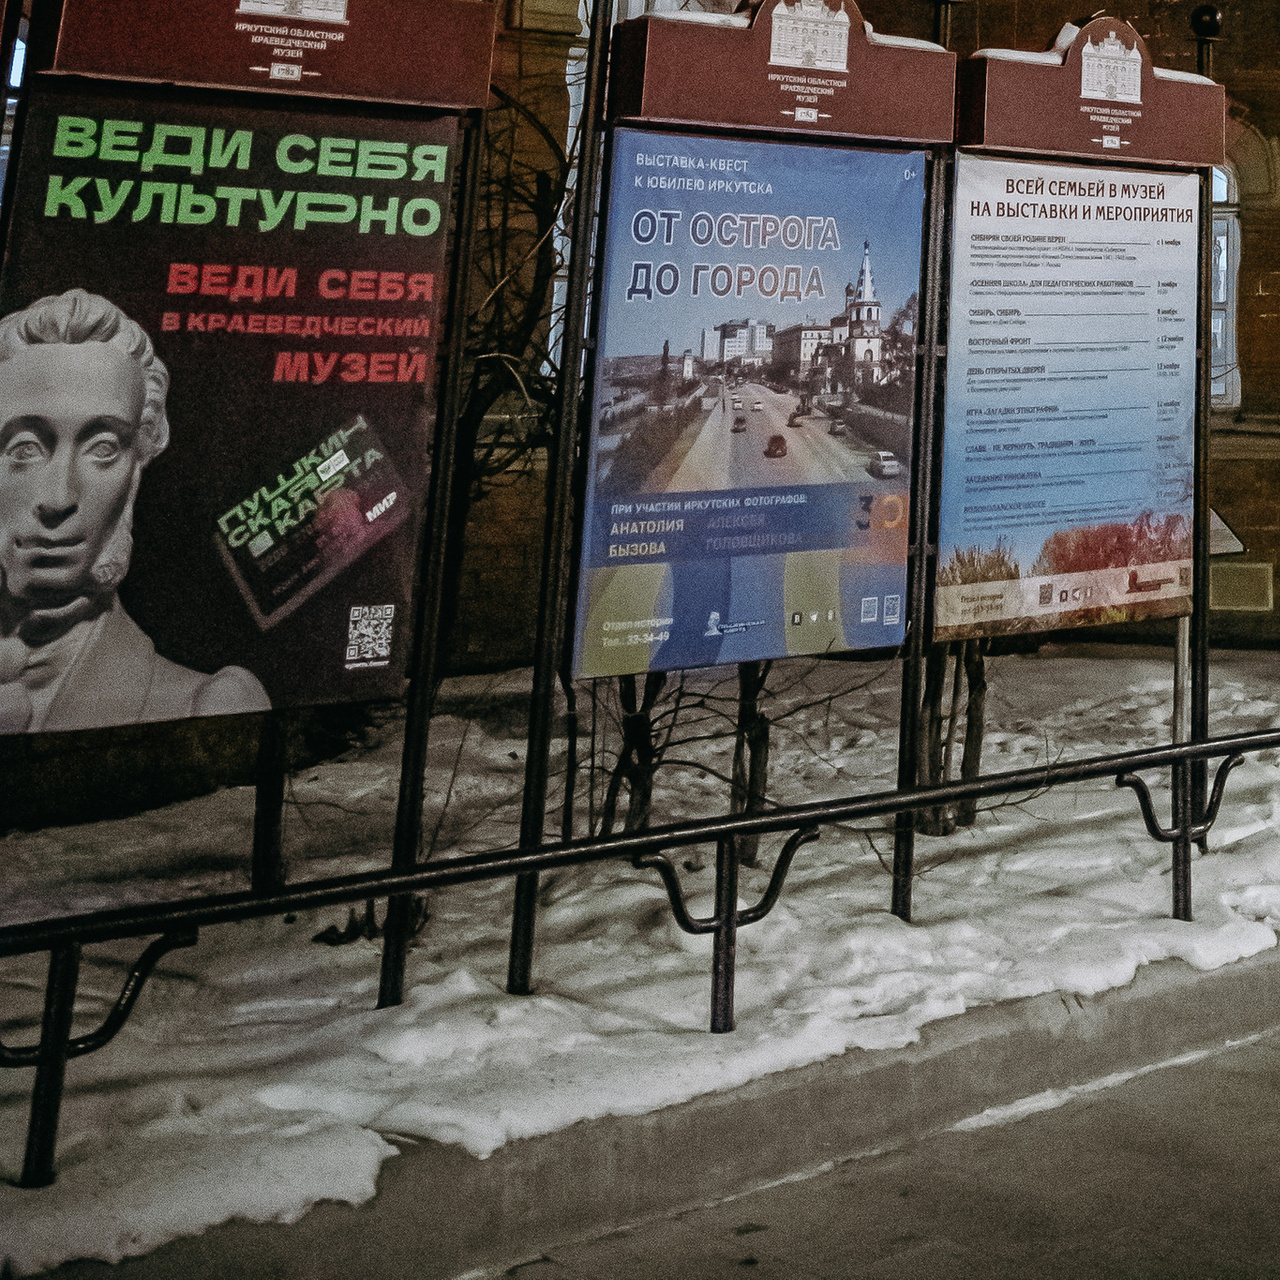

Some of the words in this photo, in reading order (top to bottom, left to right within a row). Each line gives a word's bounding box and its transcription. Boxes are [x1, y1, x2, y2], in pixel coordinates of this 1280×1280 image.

[234, 22, 289, 35] ИРКУТСКИЙ
[289, 27, 345, 42] ОБЛАСТНОЙ
[251, 35, 327, 50] КРАЕВЕДЧЕСКИЙ
[272, 47, 303, 58] МУЗЕЙ
[52, 115, 253, 175] ВЕДИ
[275, 133, 448, 183] СЕБЯ
[635, 152, 750, 172] ВЫСТАВКА-КВЕСТ
[634, 175, 643, 188] К
[647, 175, 705, 191] ЮБИЛЕЮ
[708, 178, 774, 195] ИРКУТСКА
[1005, 177, 1044, 195] ВСЕЙ
[1048, 179, 1105, 197] СЕМЬЕЙ
[1108, 185, 1118, 198] В
[1120, 182, 1165, 200] МУЗЕЙ
[43, 174, 442, 237] КУЛЬТУРНО
[969, 200, 992, 217] НА
[996, 201, 1078, 220] ВЫСТАВКИ
[1082, 205, 1092, 220] И
[1095, 205, 1194, 223] МЕРОПРИЯТИЯ
[631, 208, 683, 246] ОТ
[689, 211, 842, 252] ОСТРОГА
[166, 262, 298, 303] ВЕДИ
[318, 269, 435, 302] СЕБЯ
[625, 260, 681, 302] ДО
[690, 263, 826, 304] ГОРОДА
[160, 312, 180, 332] В
[187, 313, 431, 339] КРАЕВЕДЧЕСКИЙ
[272, 347, 428, 385] МУЗЕЙ
[365, 491, 398, 523] МИР
[610, 503, 632, 515] ПРИ
[635, 501, 681, 514] УЧАСТИИ
[684, 497, 741, 512] ИРКУТСКИХ
[610, 518, 685, 536] АНАТОЛИЯ
[608, 541, 667, 558] БЫЗОВА
